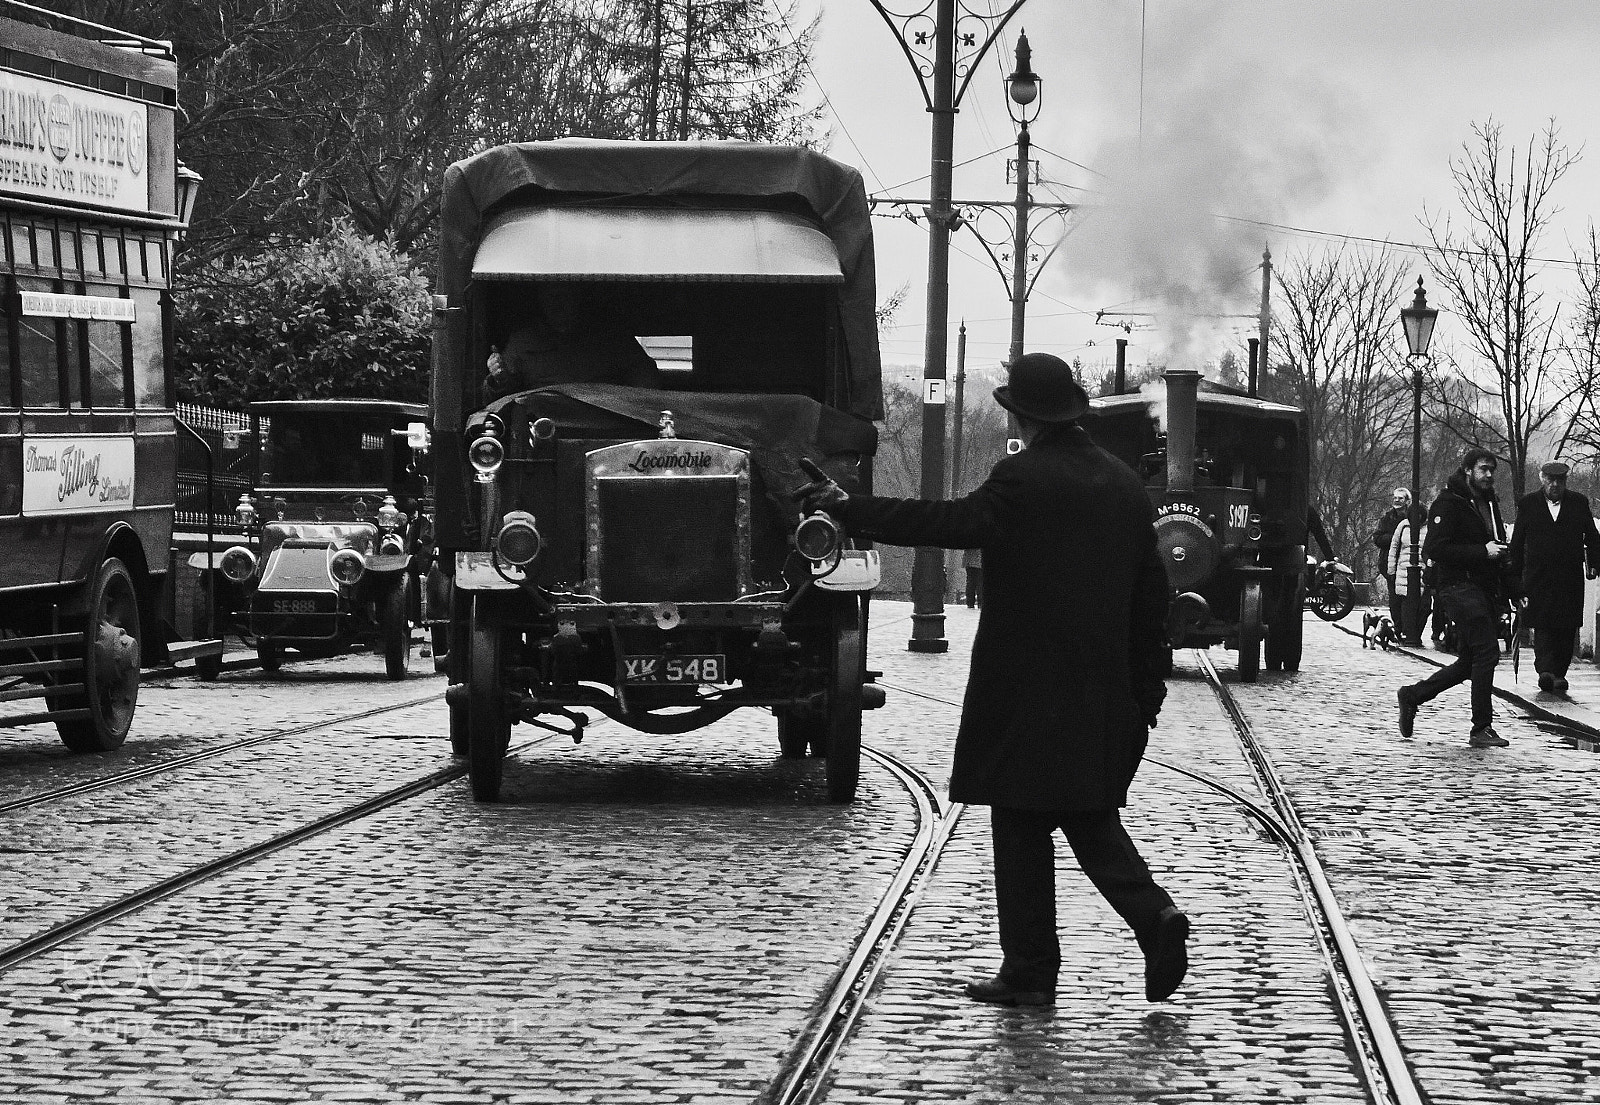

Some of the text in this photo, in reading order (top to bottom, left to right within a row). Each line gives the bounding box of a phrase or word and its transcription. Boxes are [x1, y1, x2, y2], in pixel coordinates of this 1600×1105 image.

[73, 102, 125, 167] TOFFEE
[52, 167, 76, 191] FOR
[80, 171, 118, 199] ITSELF
[930, 382, 940, 400] F
[26, 445, 57, 472] Thomas
[58, 444, 101, 502] Tilling
[628, 450, 712, 473] Locomobile
[1157, 503, 1201, 516] M-8562
[665, 659, 718, 681] 548
